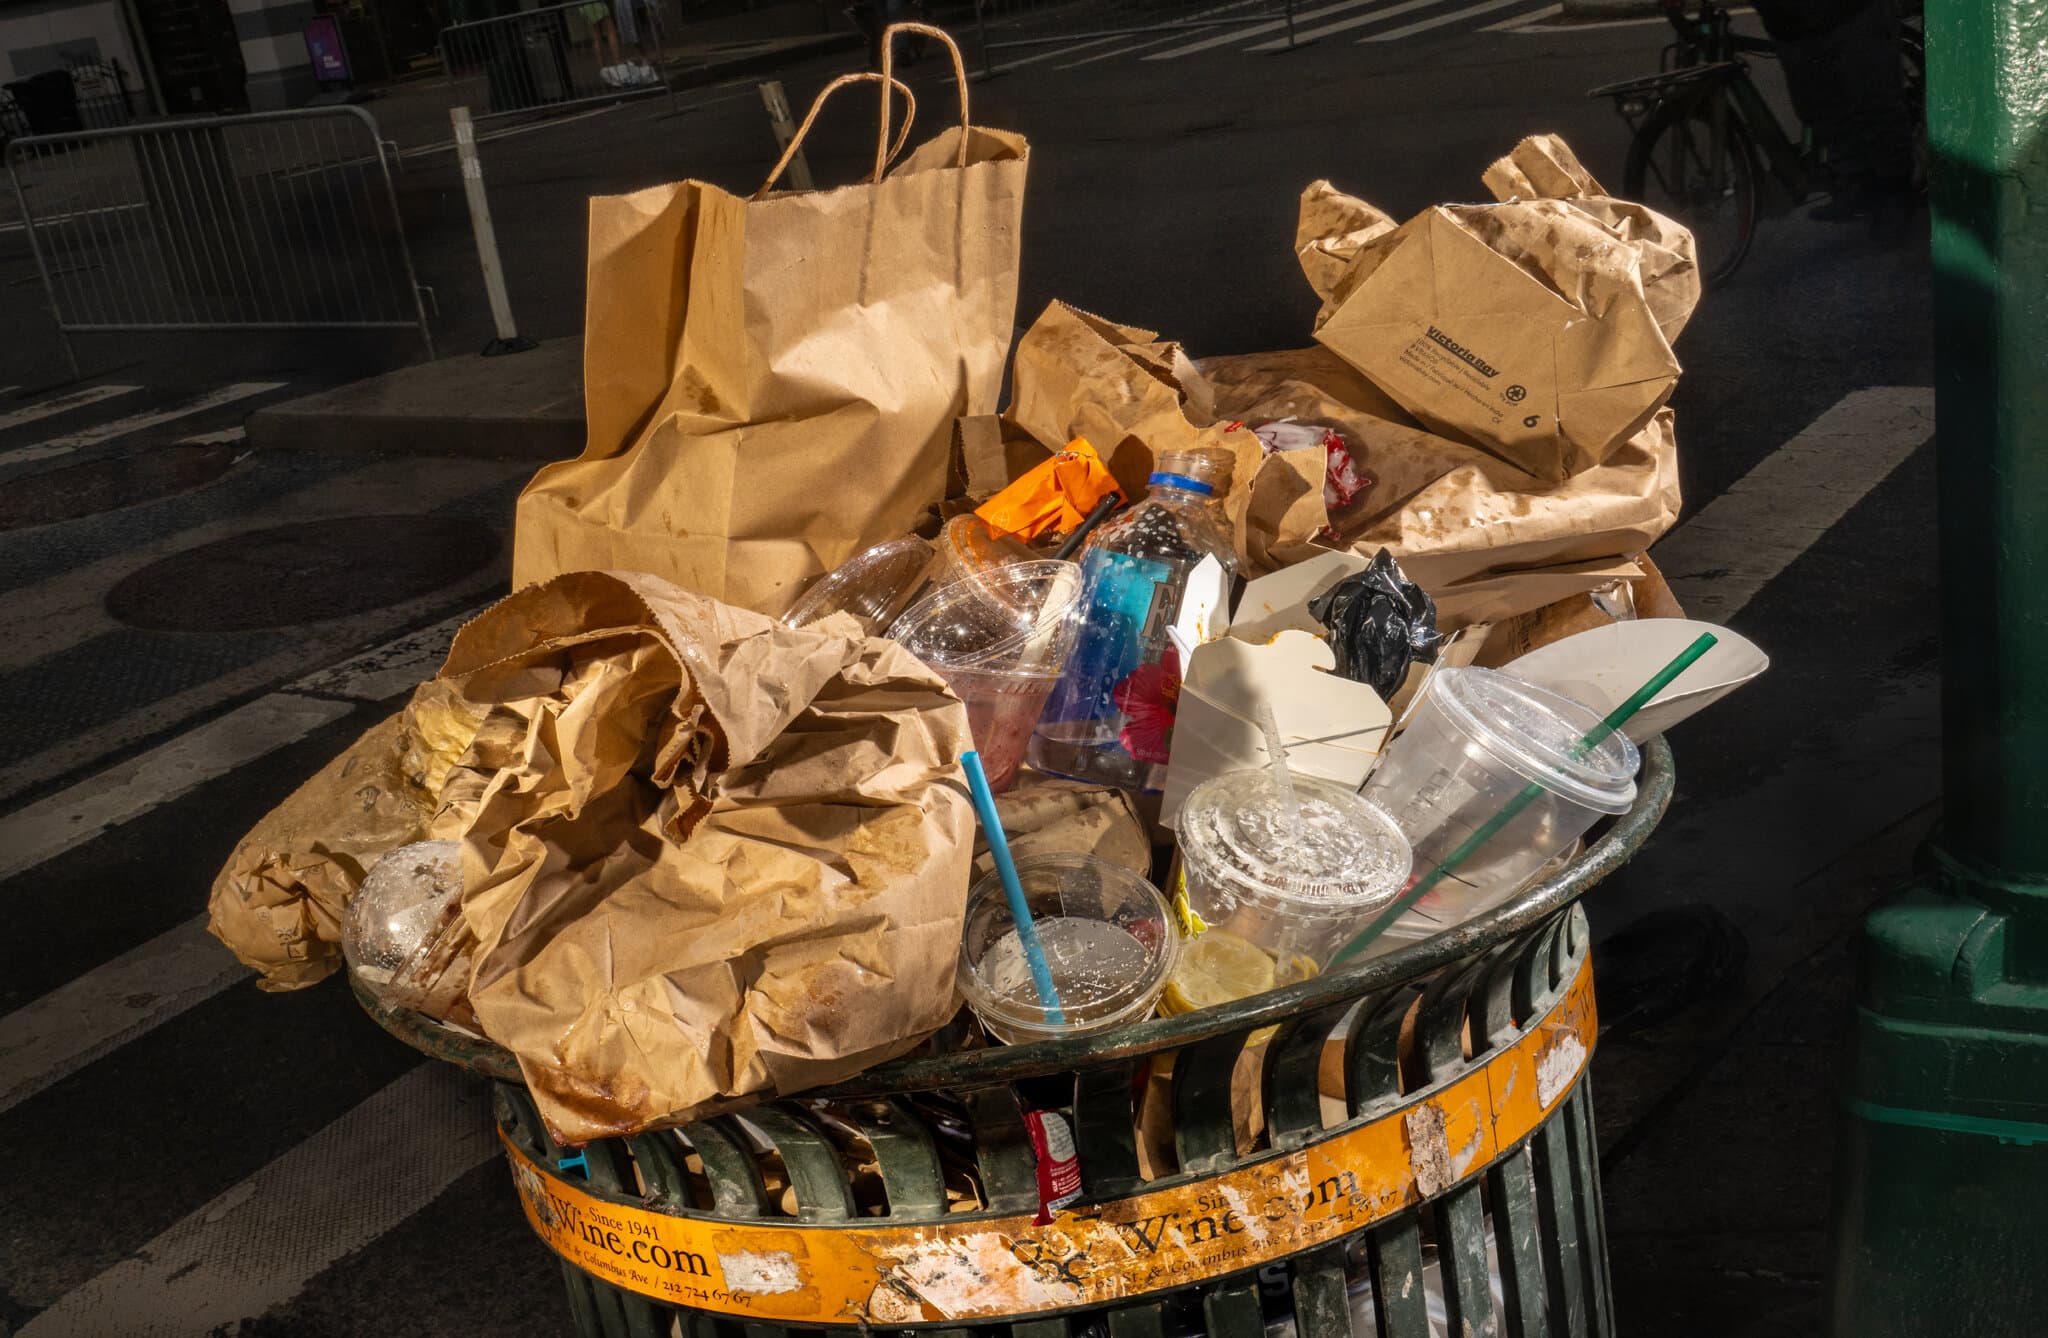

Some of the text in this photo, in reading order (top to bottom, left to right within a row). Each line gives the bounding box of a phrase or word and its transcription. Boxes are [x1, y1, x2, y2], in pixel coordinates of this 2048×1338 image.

[1426, 325, 1477, 364] Victoria
[1474, 357, 1501, 378] Bay
[1522, 414, 1541, 429] 6
[550, 1193, 712, 1278] Wine.com
[589, 1206, 661, 1241] Since 1941
[583, 1251, 627, 1278] Columbus
[629, 1269, 649, 1285] Ave
[662, 1281, 683, 1294] 212
[684, 1285, 710, 1303] 724
[712, 1289, 731, 1305] 67
[732, 1292, 753, 1308] 67
